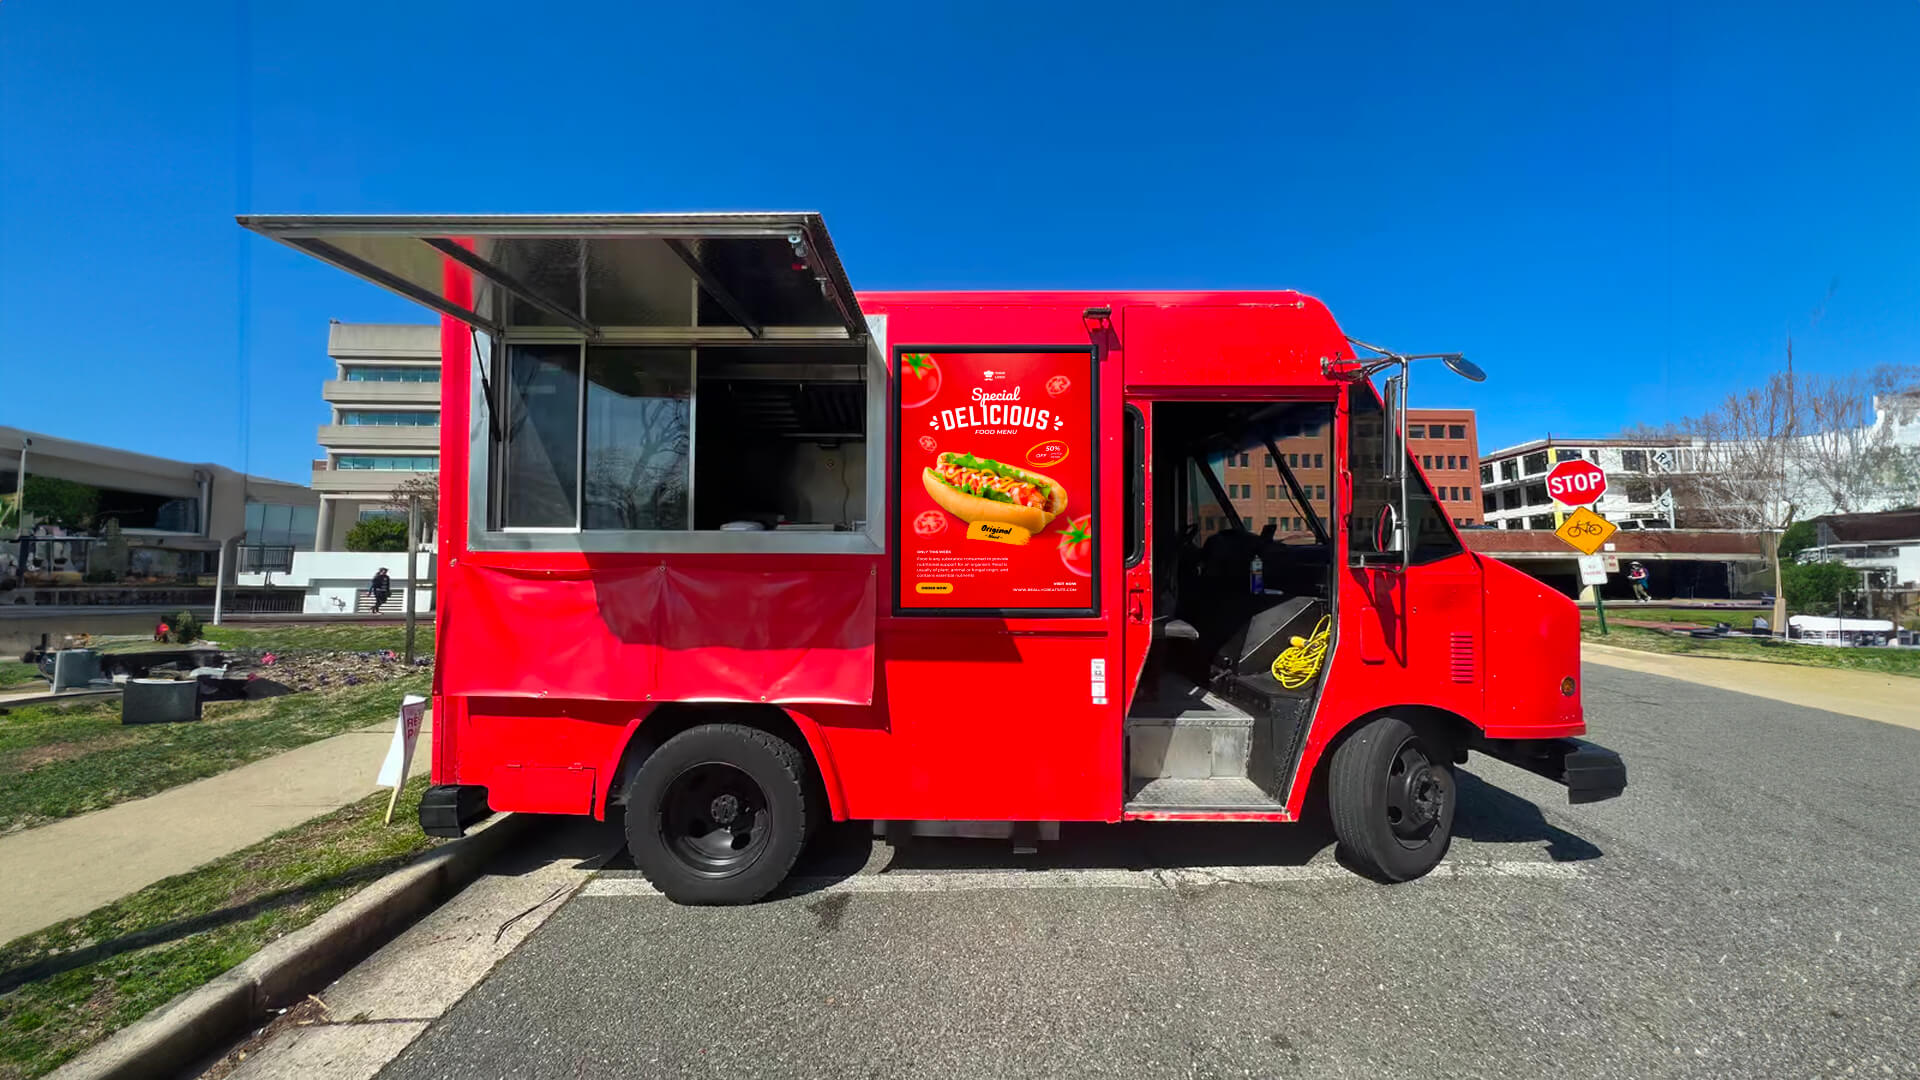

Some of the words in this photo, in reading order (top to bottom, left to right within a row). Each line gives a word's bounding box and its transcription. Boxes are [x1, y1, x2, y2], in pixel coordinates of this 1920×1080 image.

[972, 386, 1021, 407] Special
[941, 404, 1050, 431] DELICIOUS
[1551, 472, 1602, 494] STOP
[981, 524, 1013, 535] Original
